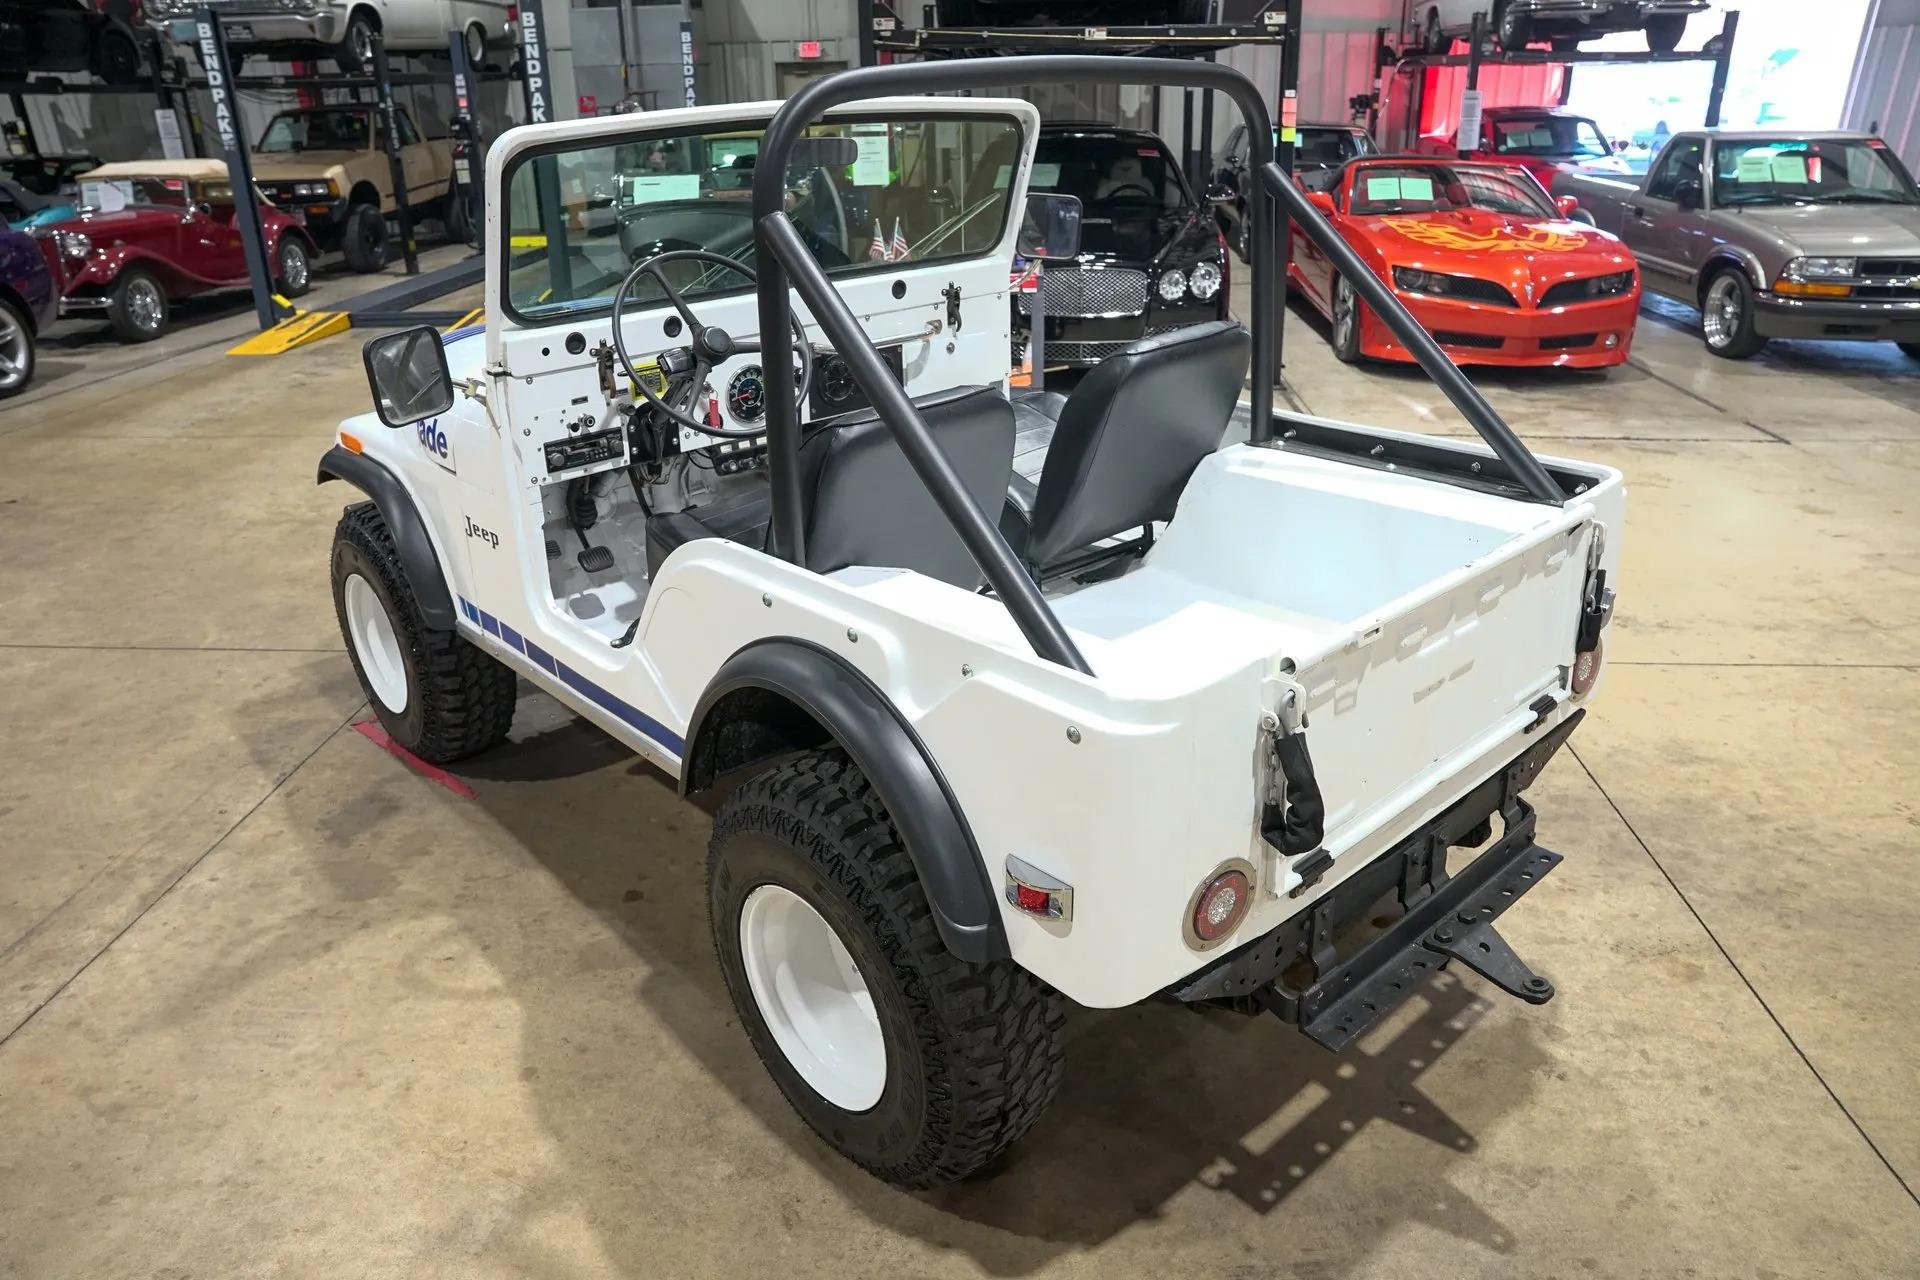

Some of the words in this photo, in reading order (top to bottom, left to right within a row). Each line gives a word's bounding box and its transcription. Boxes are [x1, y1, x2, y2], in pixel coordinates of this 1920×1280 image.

[196, 22, 233, 133] BENDPAK
[522, 11, 547, 122] BENDPAK
[681, 31, 696, 107] BENDPAK
[417, 418, 448, 459] ade
[465, 515, 499, 549] Jeep
